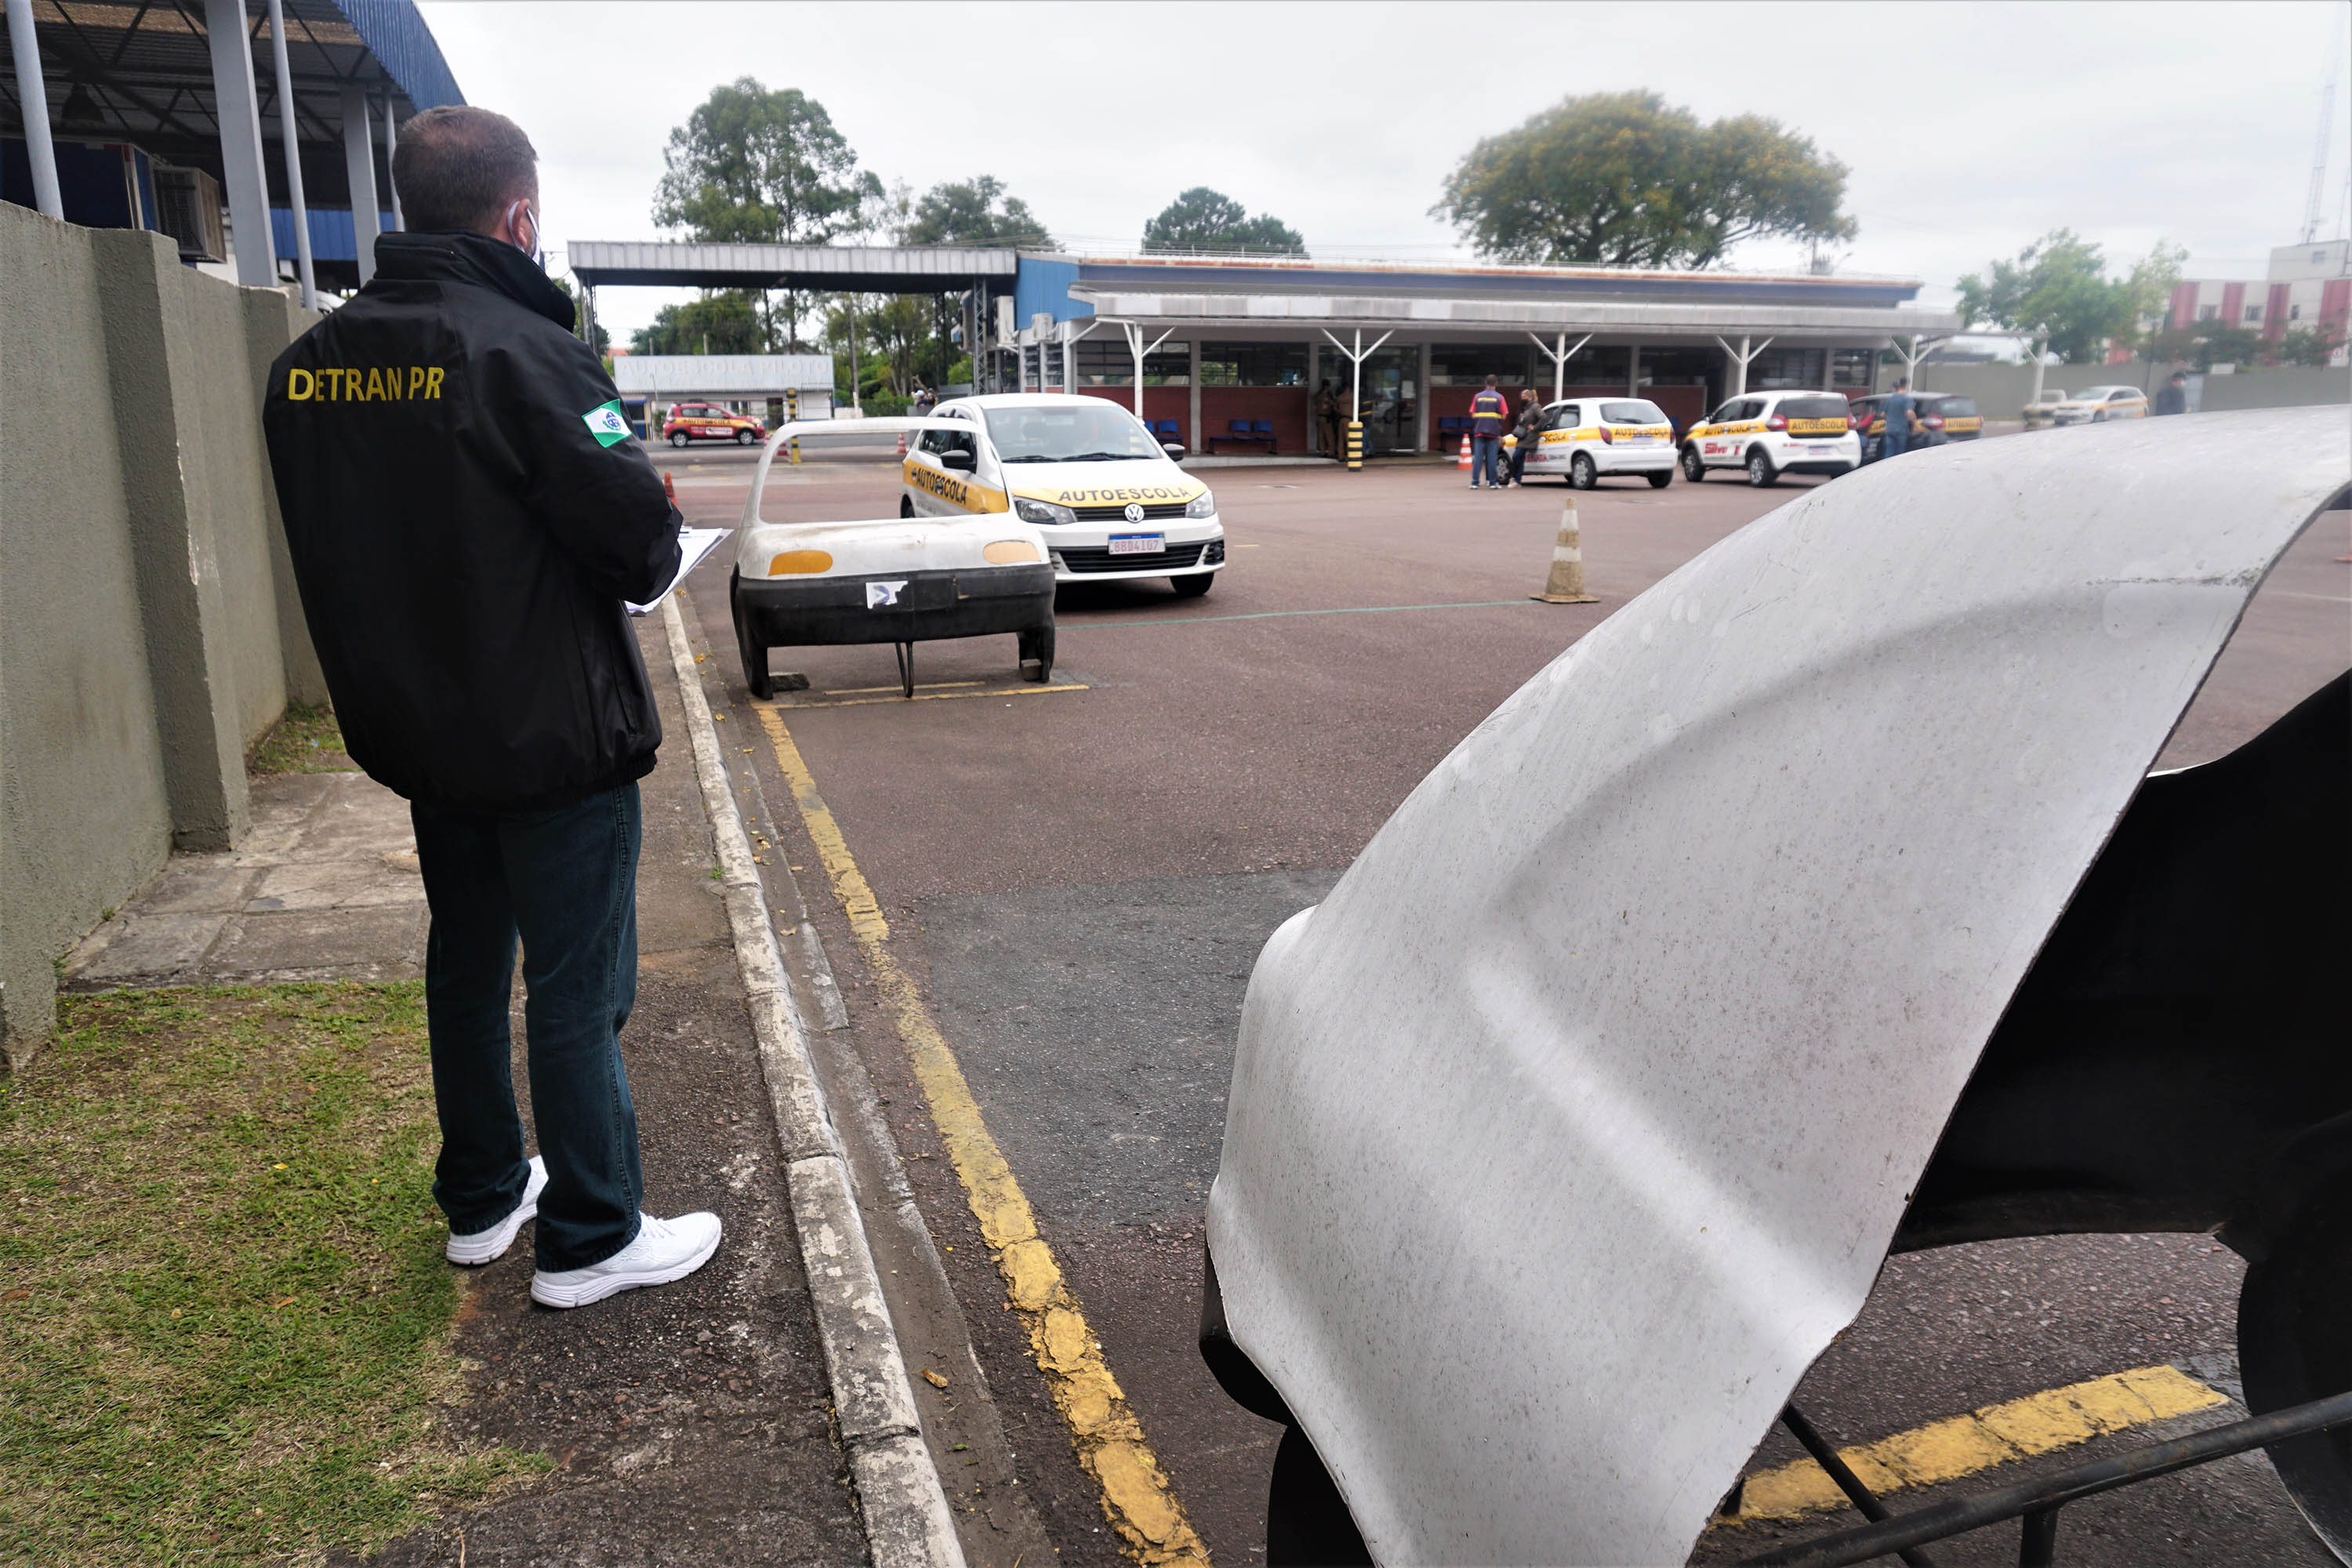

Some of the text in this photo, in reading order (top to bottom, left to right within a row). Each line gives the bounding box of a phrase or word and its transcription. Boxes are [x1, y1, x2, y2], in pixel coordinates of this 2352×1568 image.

[620, 358, 828, 376] AUTOESCOLA PILOTO
[288, 366, 445, 401] DETRAN PR
[1792, 419, 1846, 430] AUTOESCOLA
[1058, 486, 1192, 502] AUTOESCOLA
